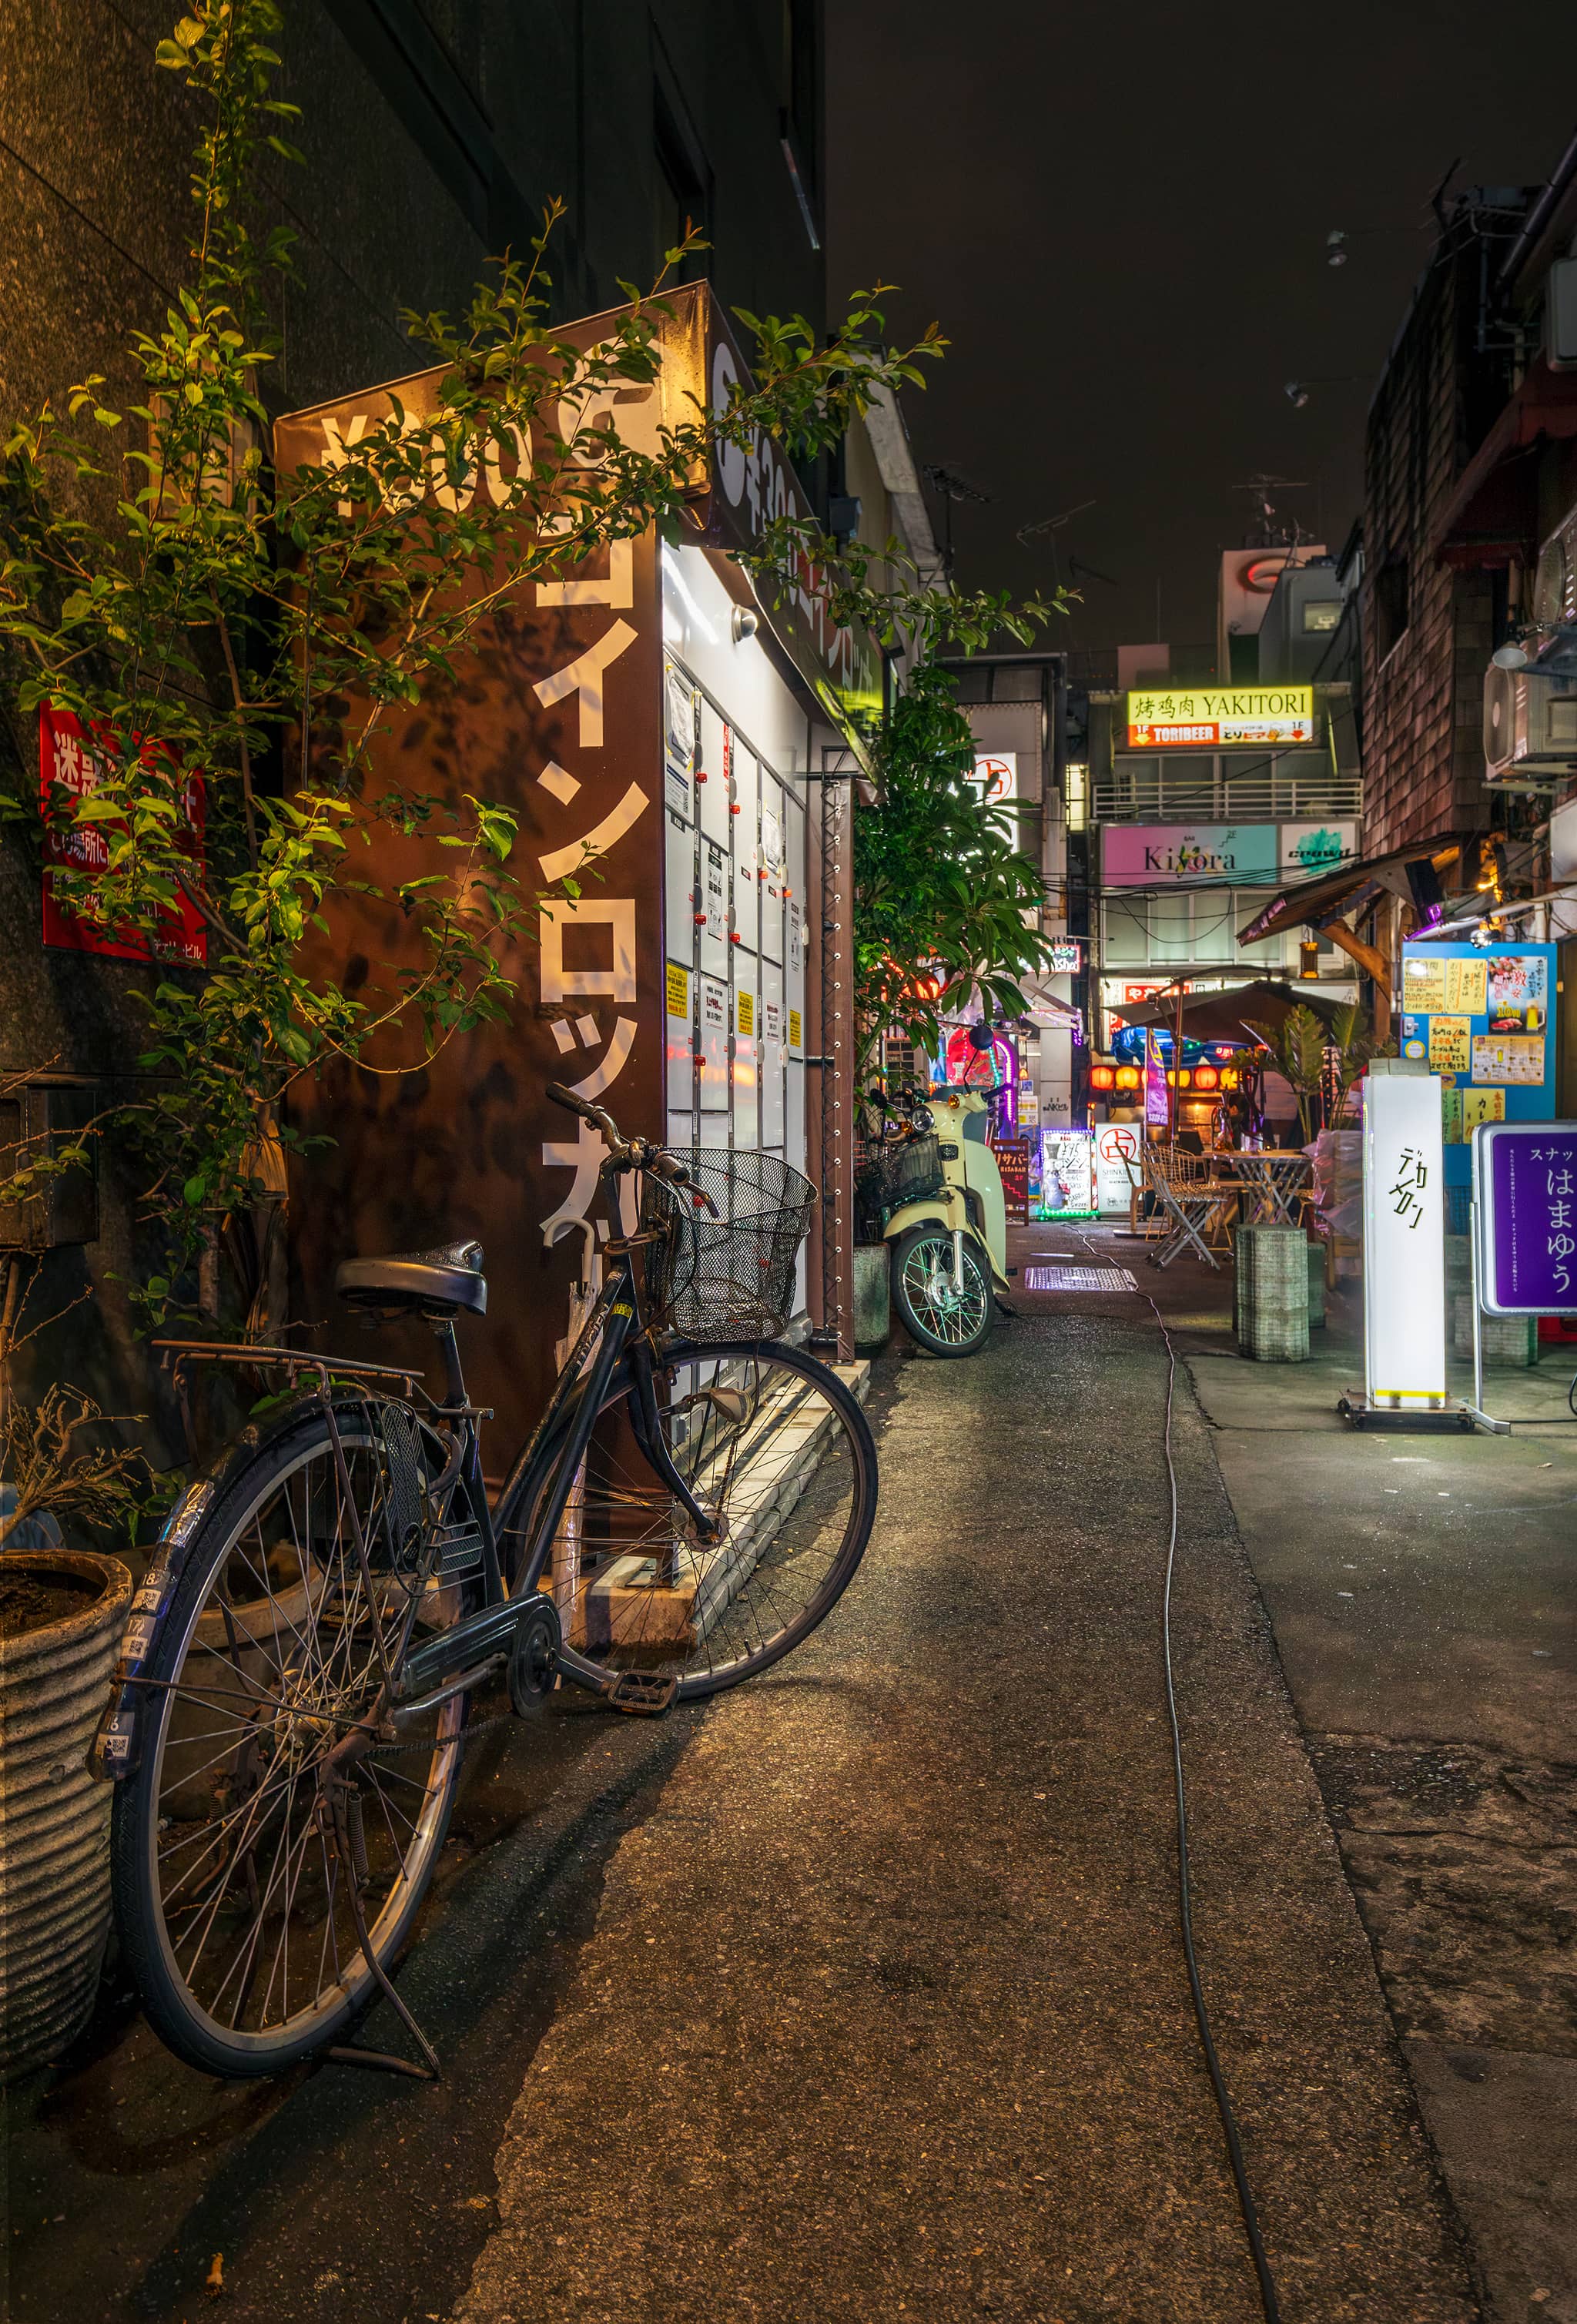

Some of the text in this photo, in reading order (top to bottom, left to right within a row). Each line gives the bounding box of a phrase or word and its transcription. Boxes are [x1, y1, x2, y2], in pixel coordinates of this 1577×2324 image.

[1135, 693, 1307, 719] 烤鸡肉 YAKITORI
[1137, 725, 1150, 734] 1F
[1153, 726, 1214, 742] TORIBEER
[1293, 721, 1304, 729] 1F
[1143, 846, 1236, 878] Kiyora
[1287, 848, 1351, 859] crowd
[1105, 1130, 1134, 1159] 占
[1546, 1168, 1575, 1294] はまゆう
